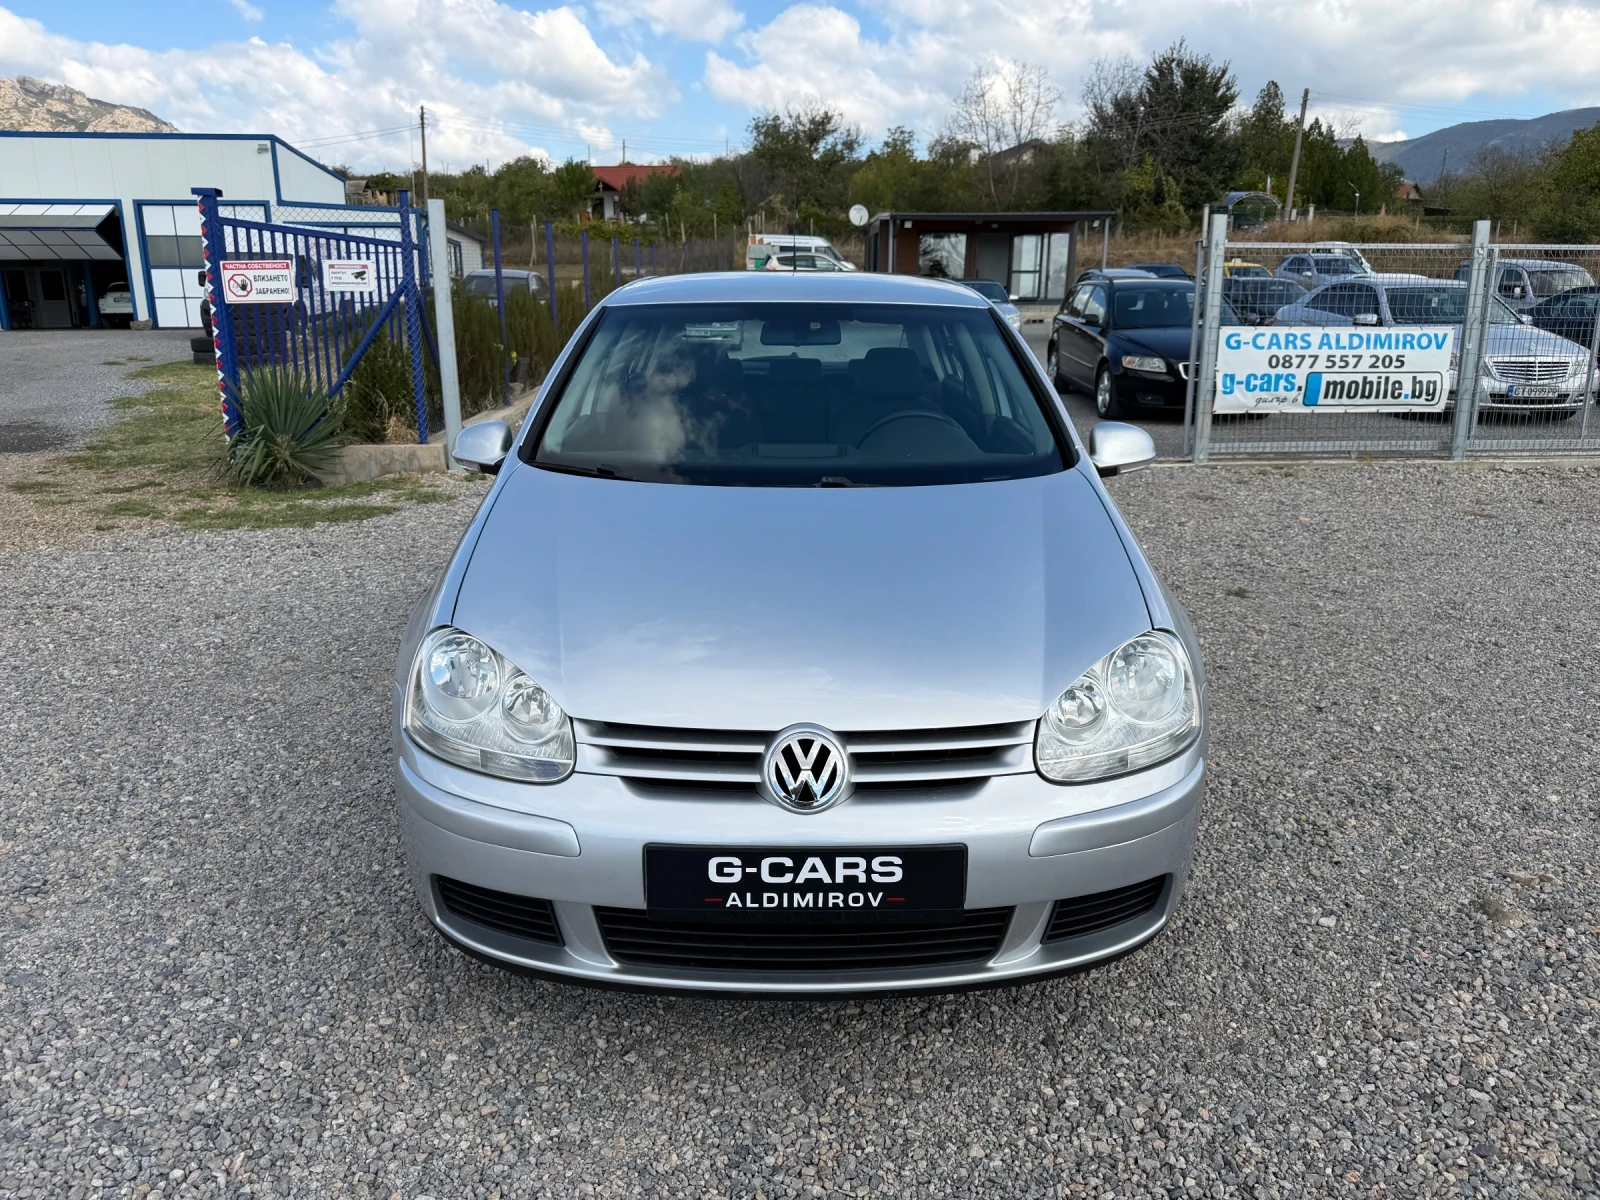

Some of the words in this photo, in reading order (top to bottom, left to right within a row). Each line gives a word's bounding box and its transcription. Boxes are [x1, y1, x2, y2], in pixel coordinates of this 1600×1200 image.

[253, 274, 288, 282] ВЛИЗАНЕТО
[255, 287, 290, 295] ЗАБРАНЕНО!
[1225, 332, 1312, 351] G-CARS
[1317, 332, 1449, 351] ALDIMIROV
[1268, 354, 1320, 369] 0877
[1325, 354, 1363, 369] 557
[1368, 354, 1405, 369] 205
[1323, 375, 1438, 402] mobile.bg
[708, 856, 904, 884] G-CARS
[725, 892, 884, 908] ALDIMIROV
